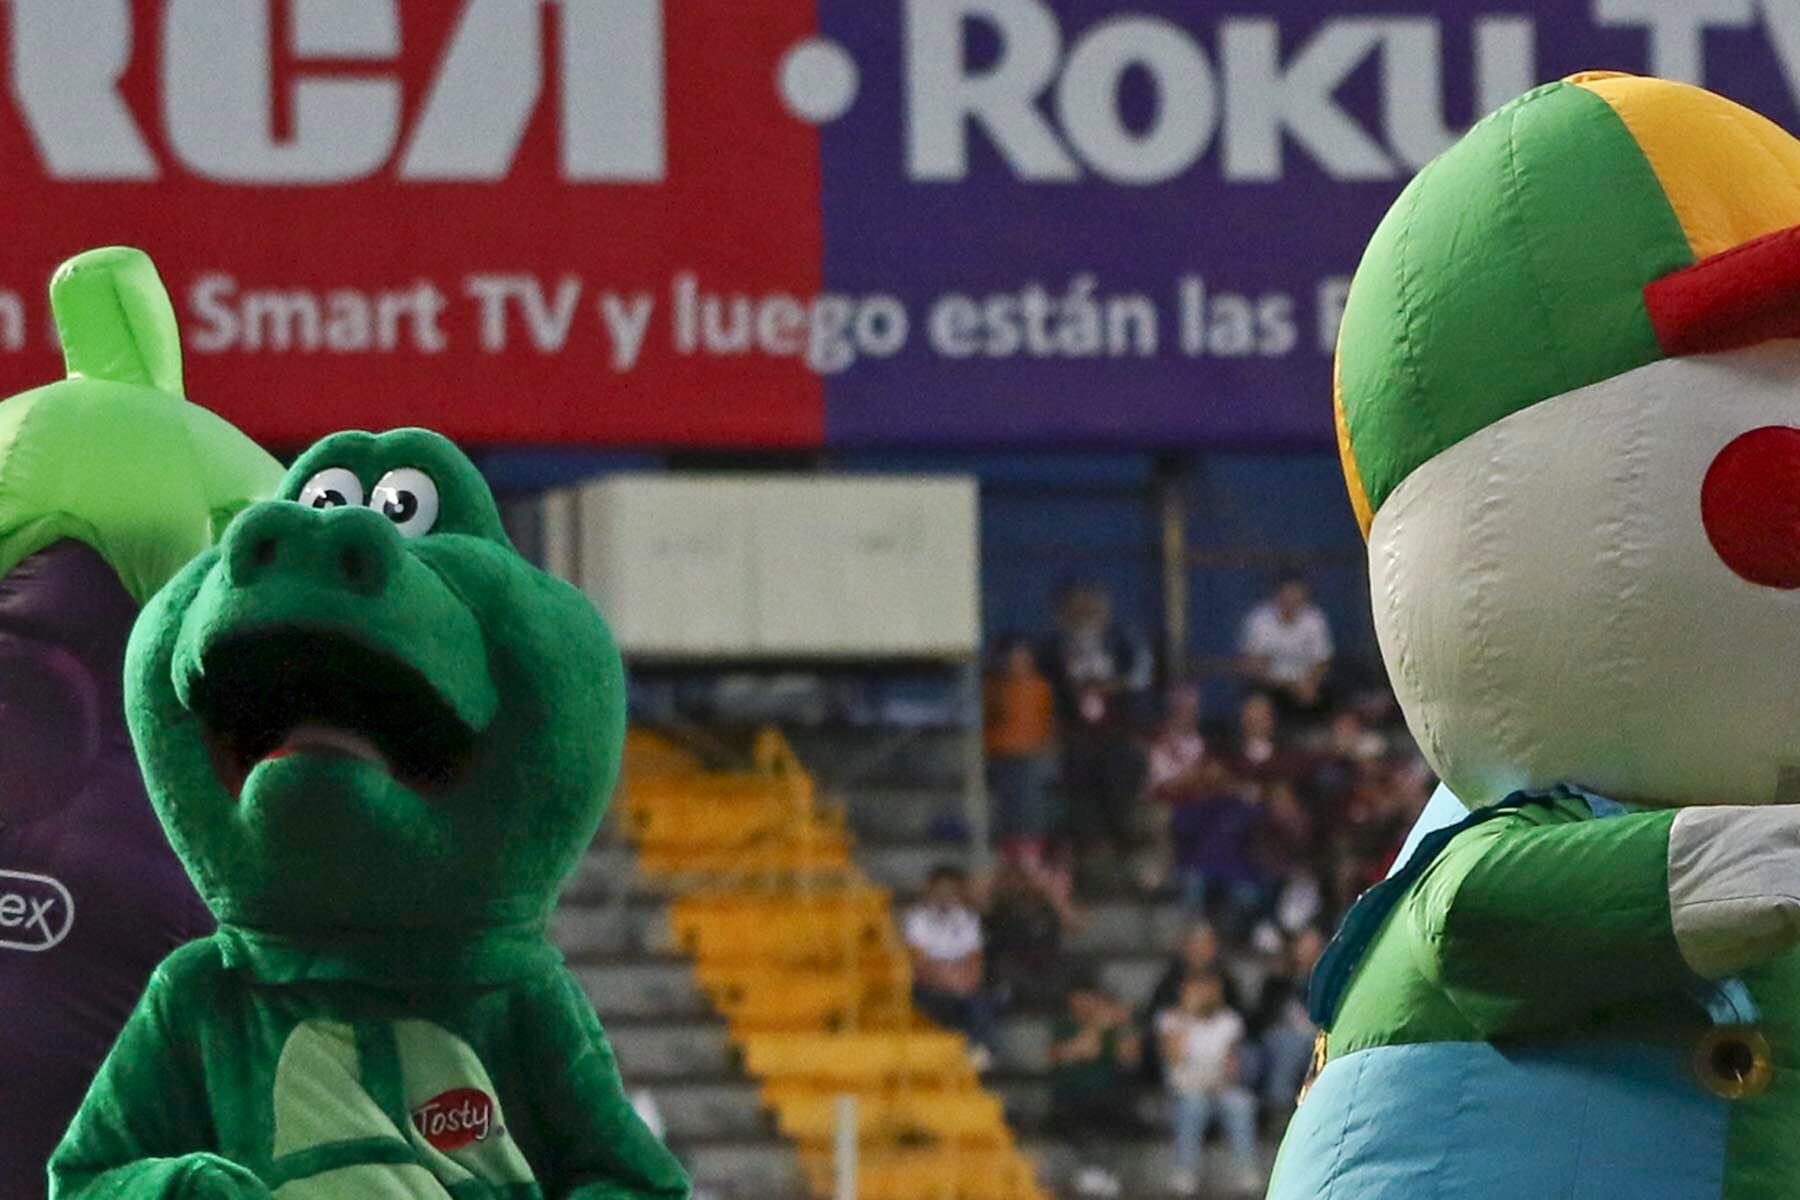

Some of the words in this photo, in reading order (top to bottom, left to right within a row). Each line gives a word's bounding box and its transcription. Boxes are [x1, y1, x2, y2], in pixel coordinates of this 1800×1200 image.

[8, 0, 667, 186] RCA
[191, 272, 447, 352] Smart
[464, 274, 582, 354] TV
[600, 292, 653, 373] y
[671, 272, 908, 376] luego
[930, 272, 1158, 358] están
[1178, 276, 1297, 358] las
[414, 1099, 489, 1140] Tosty
